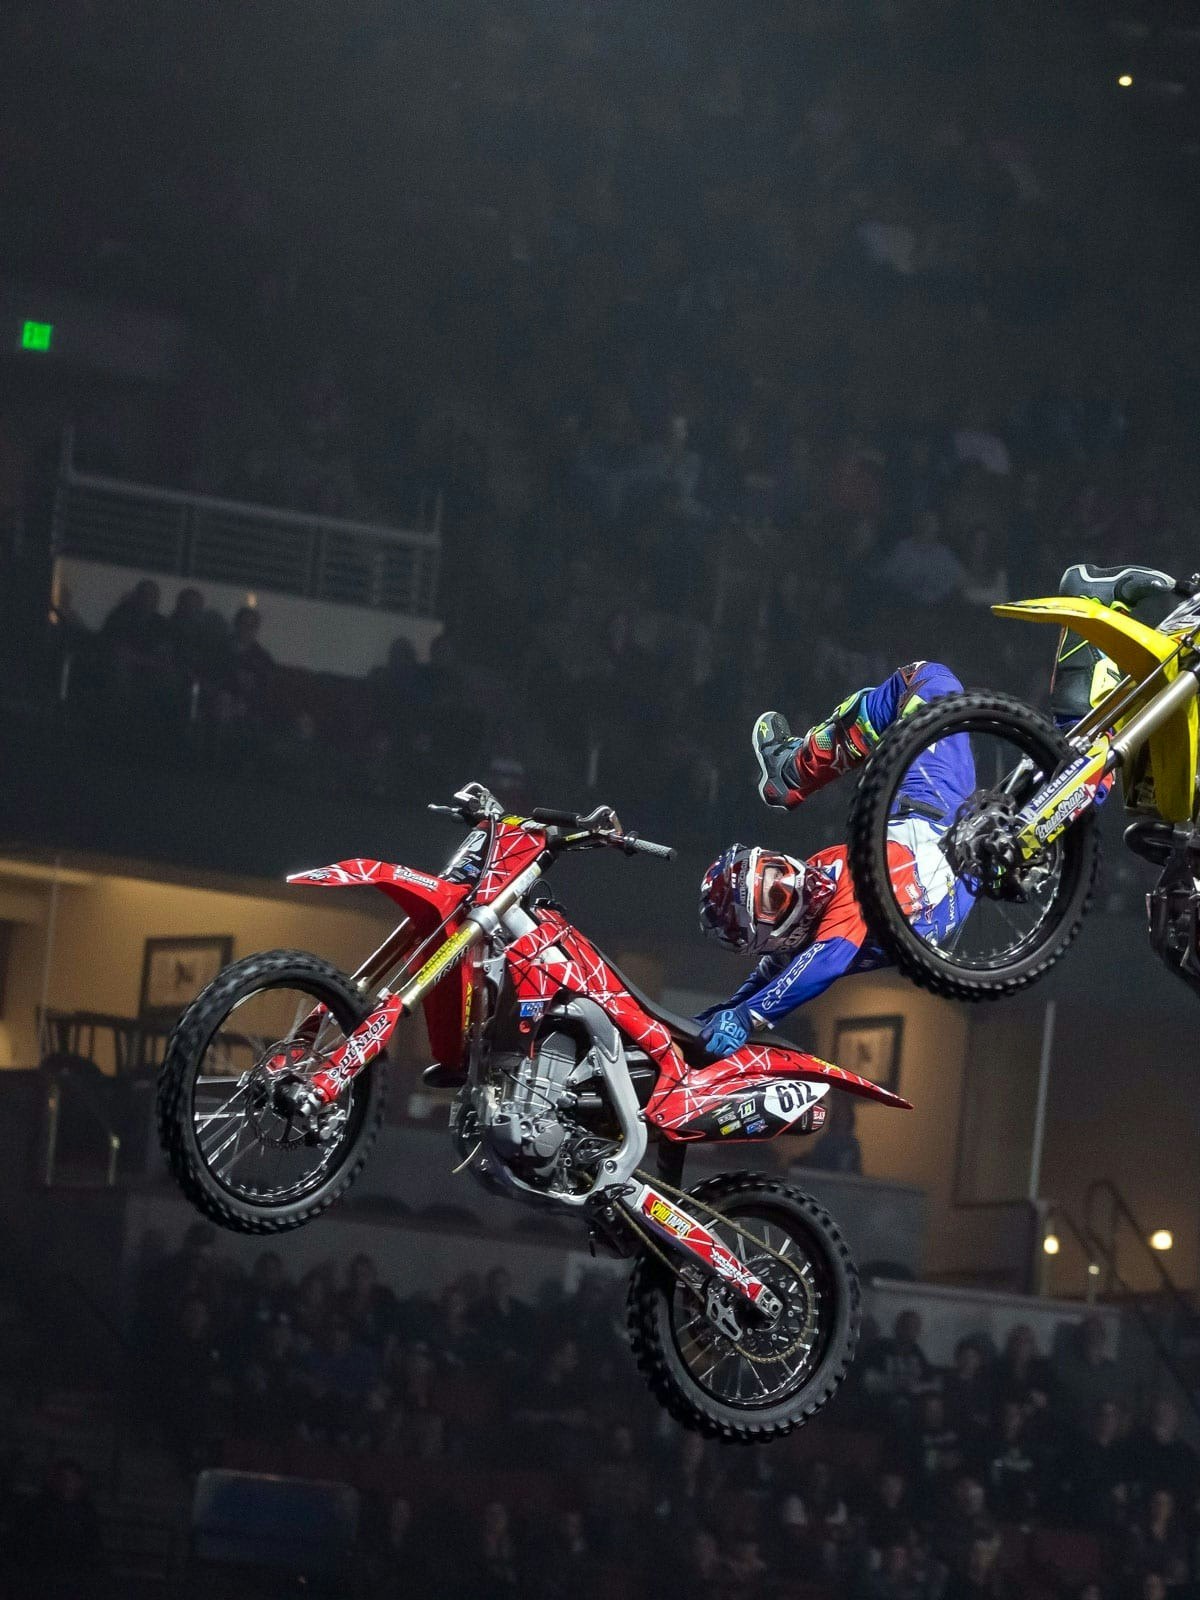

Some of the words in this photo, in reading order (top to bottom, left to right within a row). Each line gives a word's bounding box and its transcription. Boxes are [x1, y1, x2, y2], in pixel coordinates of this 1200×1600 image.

[1034, 758, 1085, 807] MICHELIN
[340, 1013, 388, 1068] DUNLOP
[775, 1081, 818, 1113] 612
